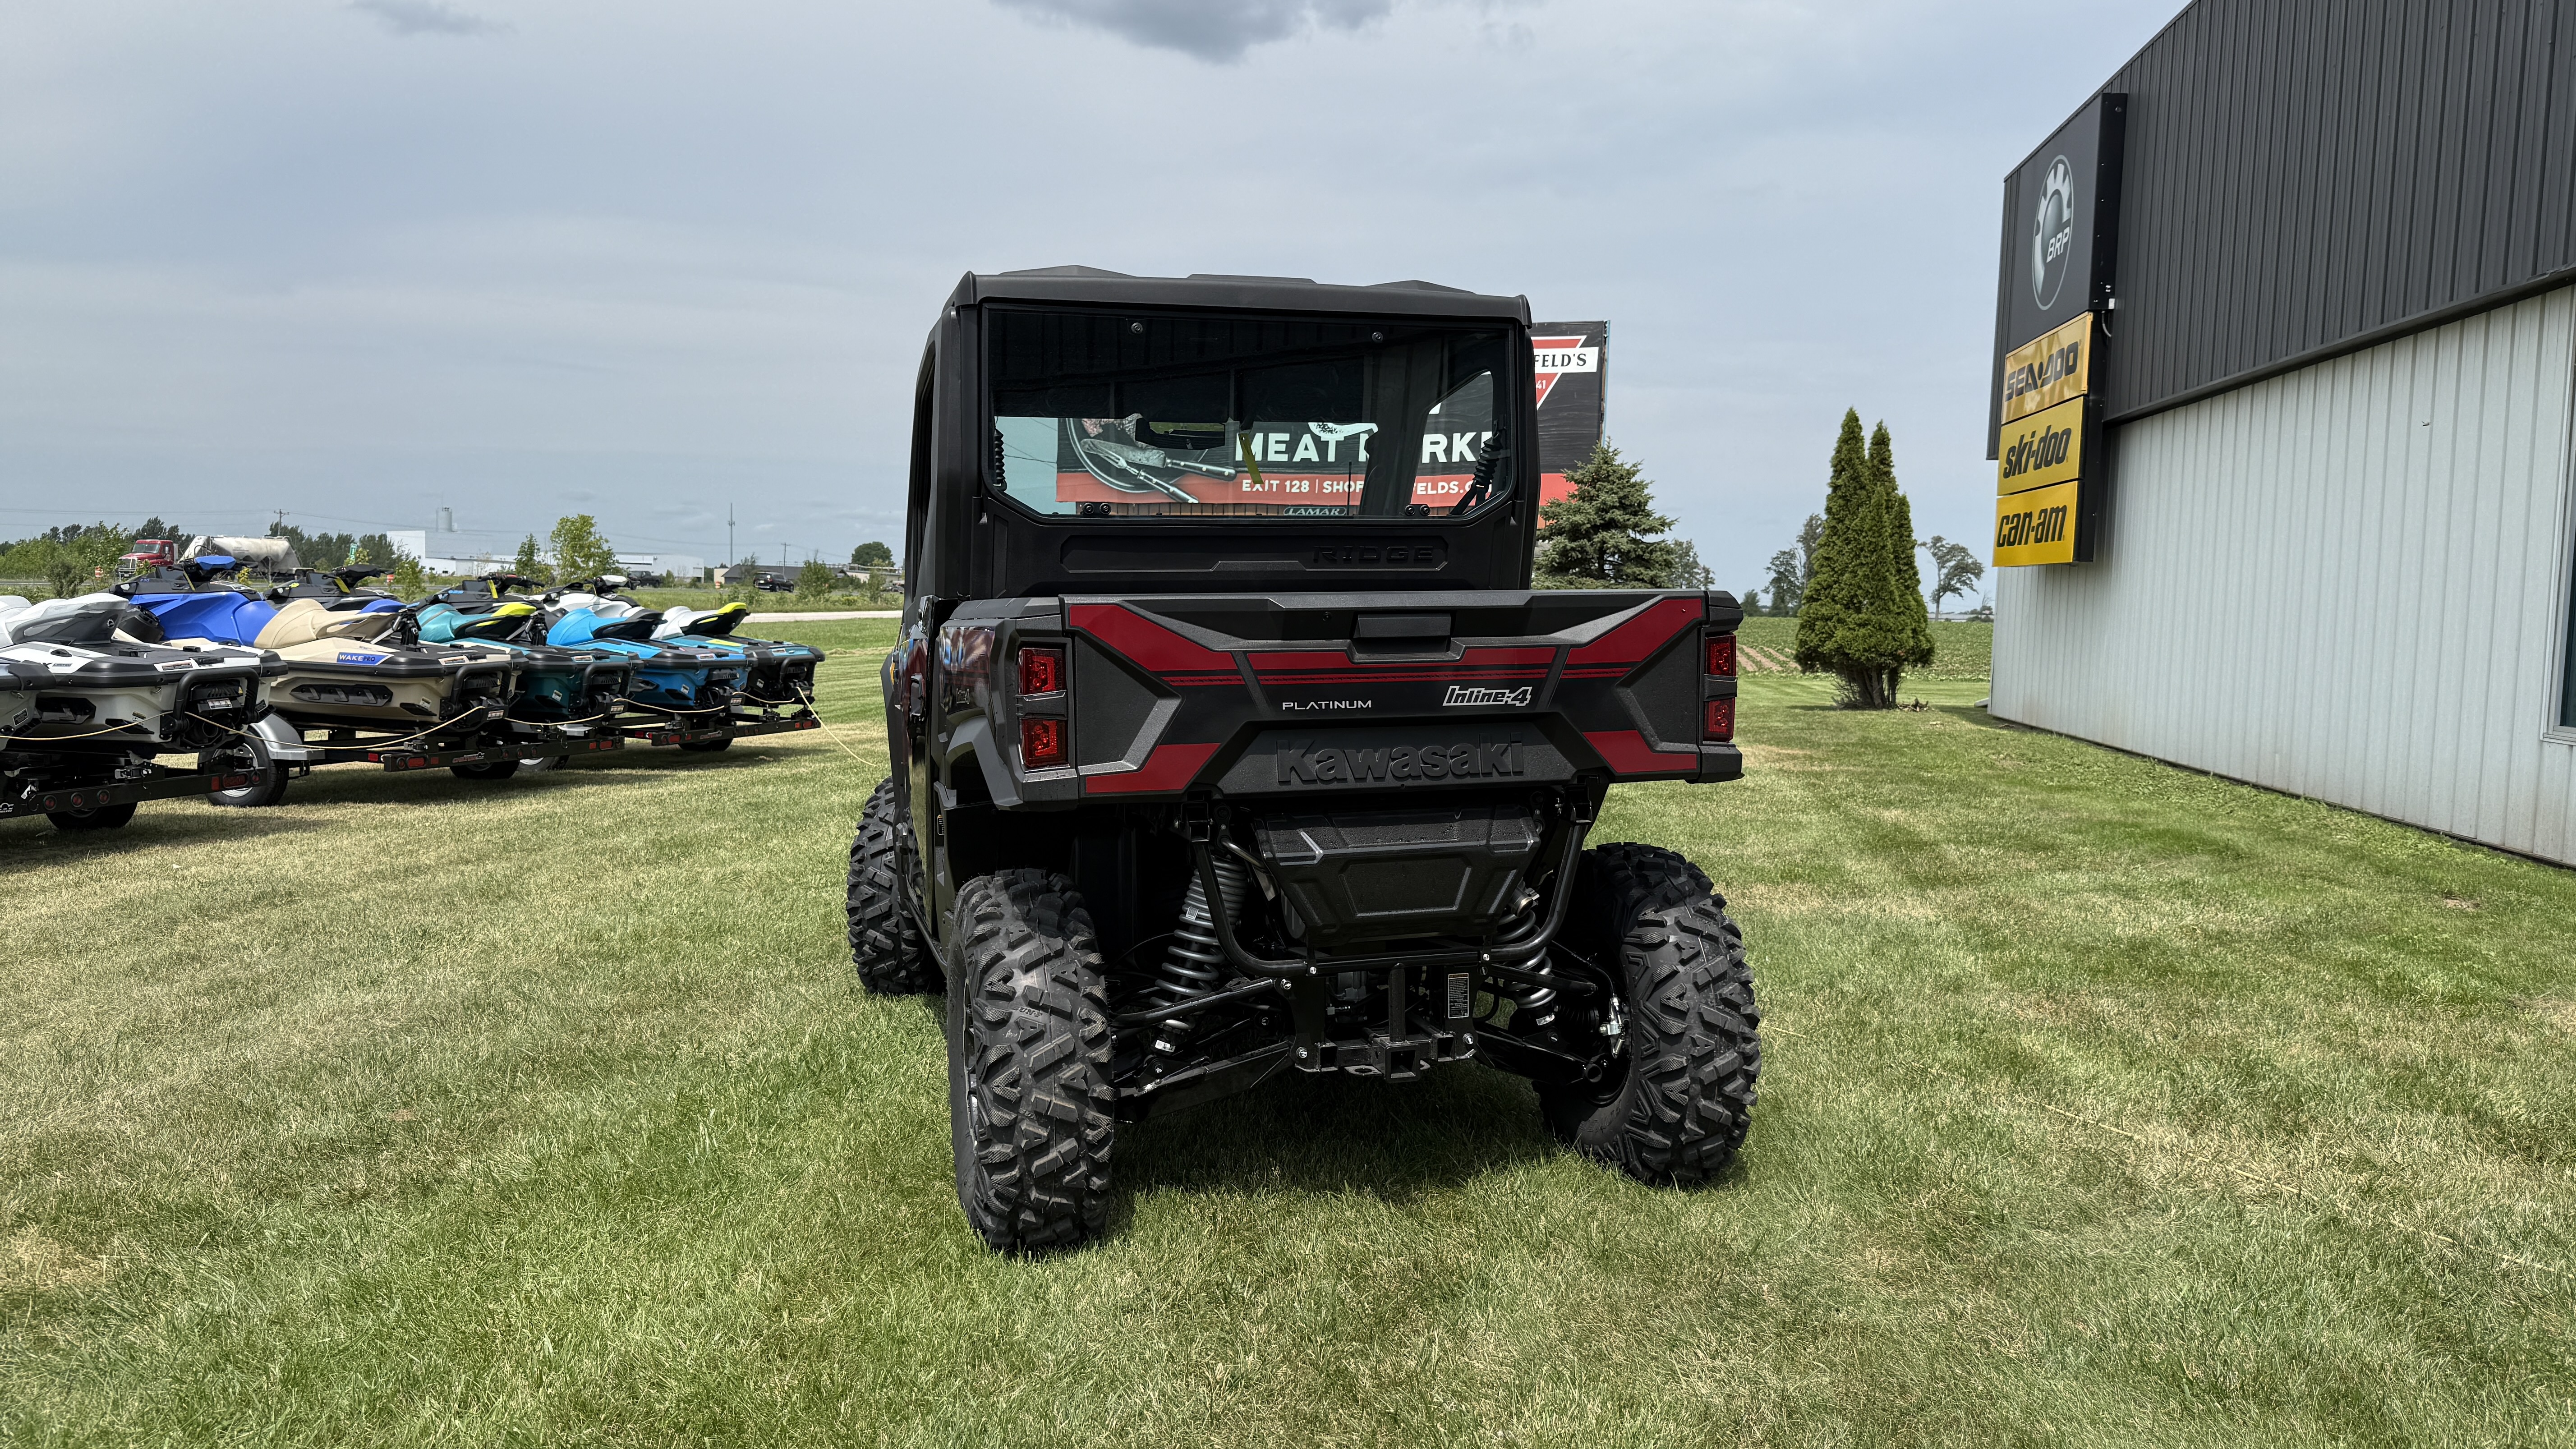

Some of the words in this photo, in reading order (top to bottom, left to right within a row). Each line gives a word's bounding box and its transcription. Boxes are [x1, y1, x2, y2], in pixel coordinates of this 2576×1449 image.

[2046, 226, 2070, 263] BRP
[1235, 433, 1344, 462] MEAT
[2003, 425, 2072, 478] ski-doo
[1242, 480, 1280, 492] EXIT
[1285, 480, 1310, 492] 128
[1288, 507, 1340, 515] LAMAR
[1996, 505, 2067, 547] can-am
[1313, 546, 1433, 563] RIDGE
[1282, 700, 1371, 710] PLATINUM
[1443, 685, 1532, 706] Inline-4
[1276, 732, 1524, 784] Kawasaki
